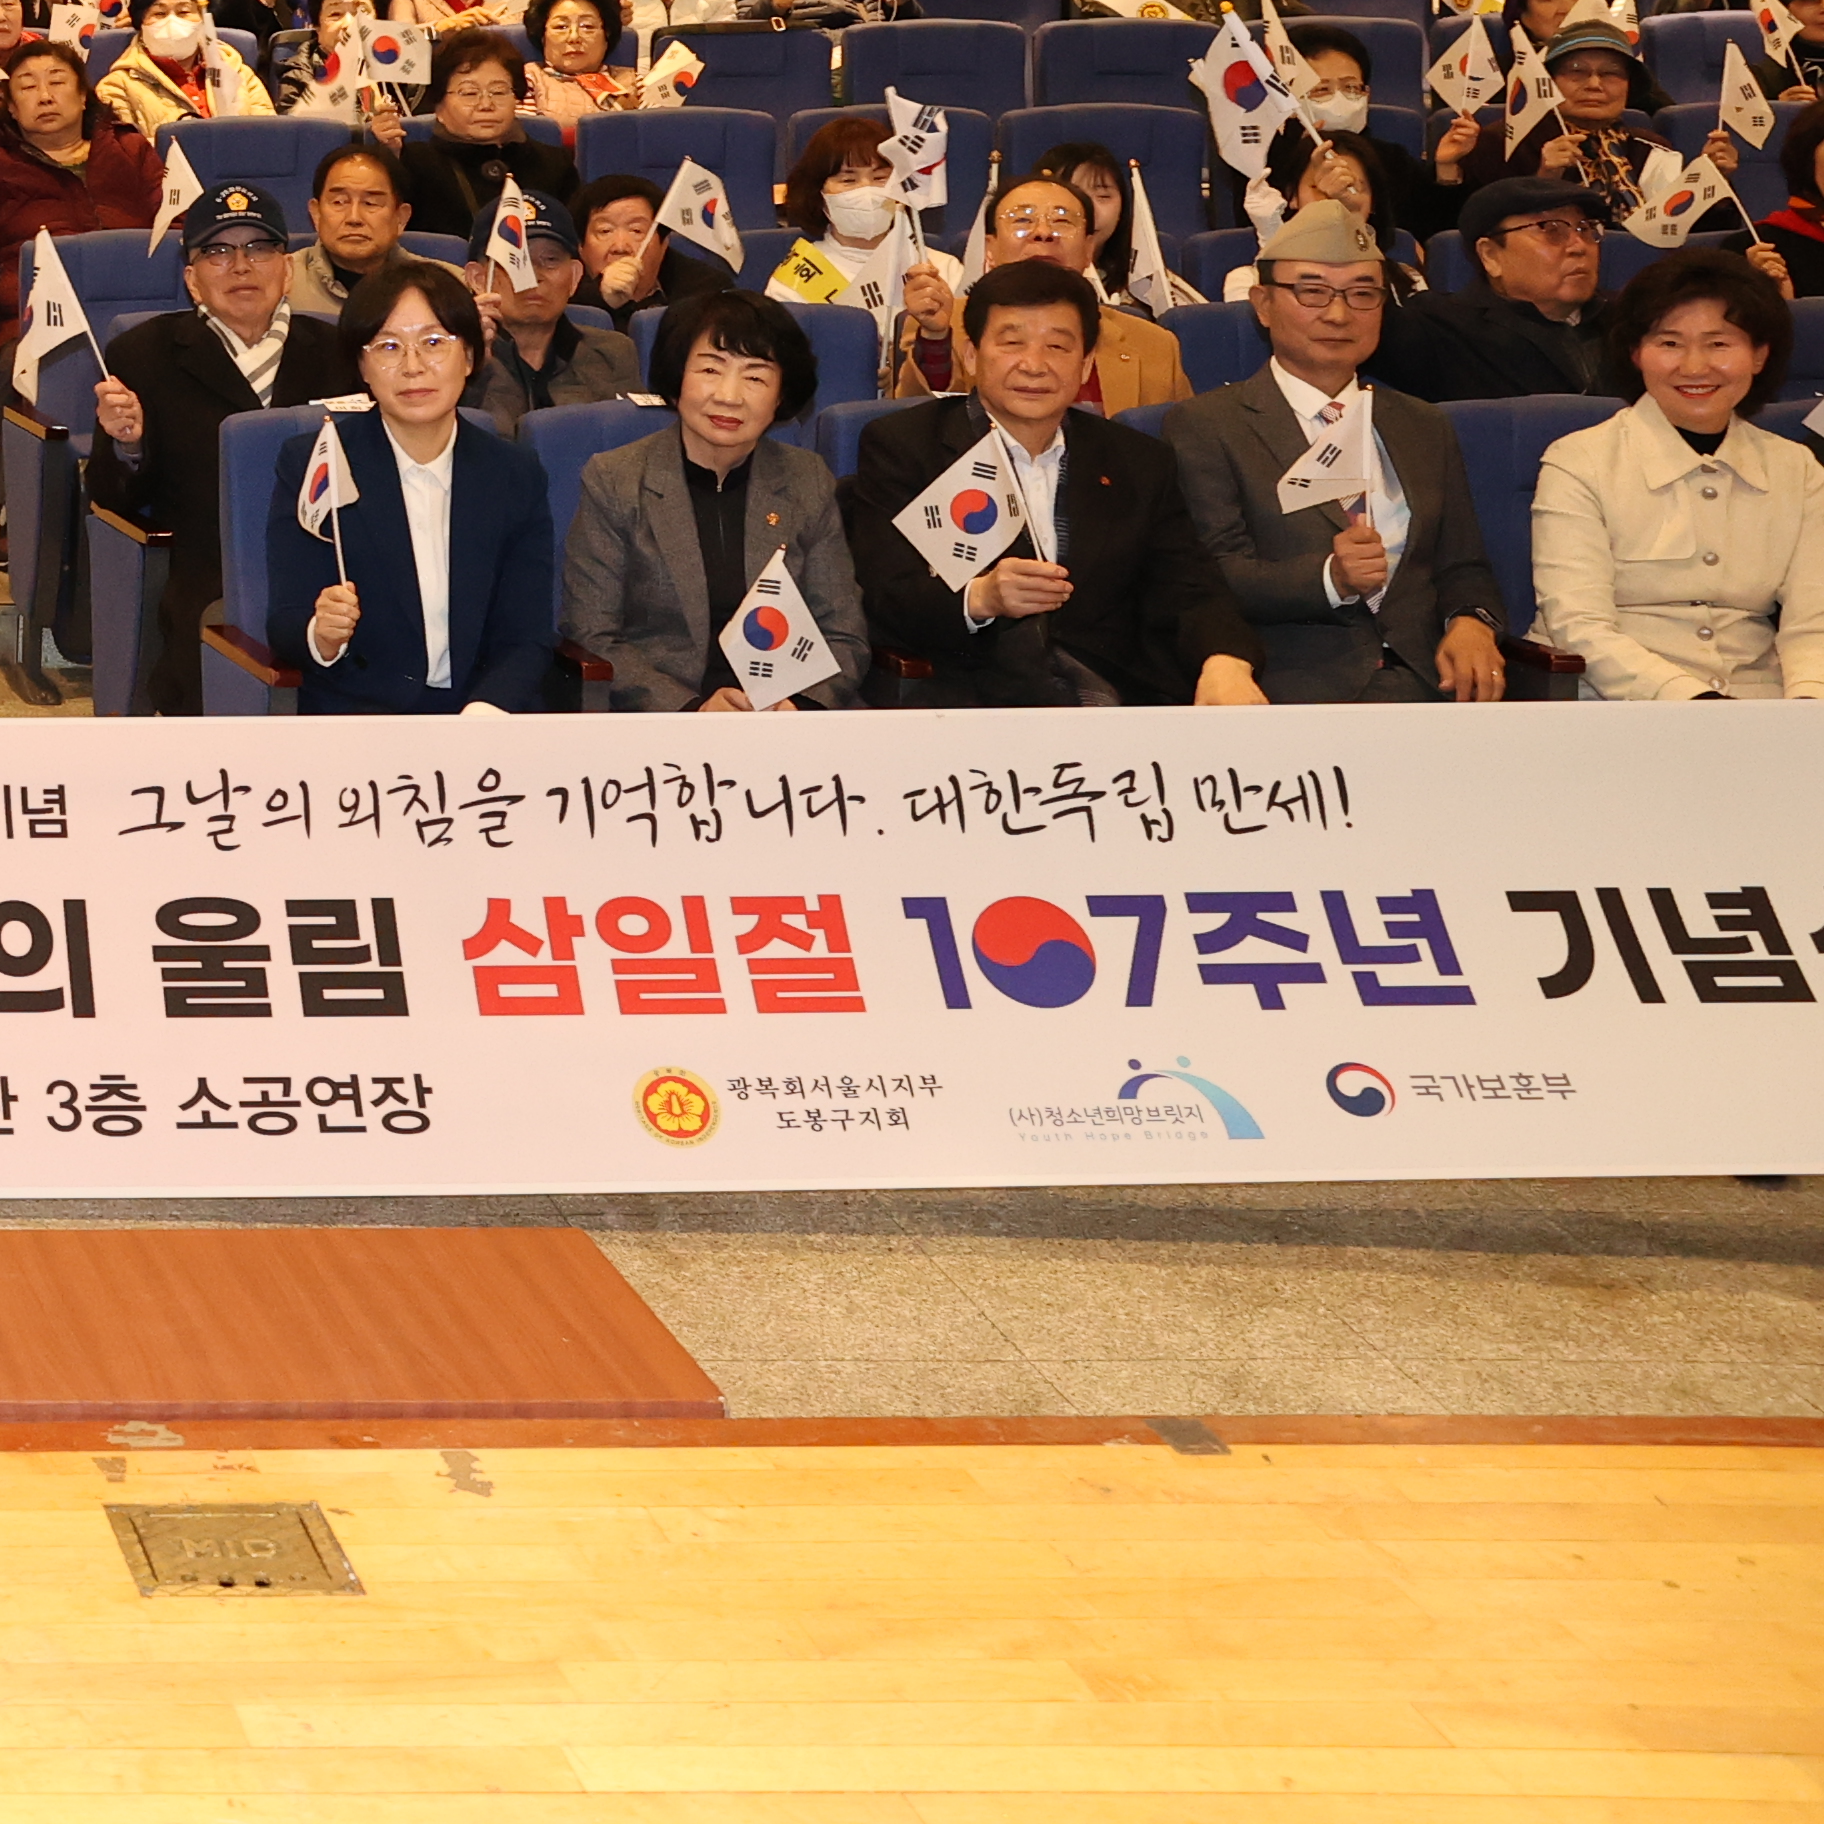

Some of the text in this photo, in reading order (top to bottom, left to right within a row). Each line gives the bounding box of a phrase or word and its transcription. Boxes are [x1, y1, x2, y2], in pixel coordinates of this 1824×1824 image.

[119, 761, 1352, 851] 그날의 외침을 기억합니다. 대한독립 만세!
[152, 897, 409, 1018] 울림
[462, 894, 866, 1016] 삼일절
[1505, 886, 1823, 1004] 기념
[726, 1075, 943, 1100] 광복회서울시지부
[1410, 1072, 1576, 1102] 국가보훈부
[46, 1075, 147, 1137] 3층
[176, 1073, 433, 1136] 소공연장
[1009, 1104, 1204, 1127] (사)청소년희망브릿지
[777, 1107, 909, 1132] 도봉구지회
[1085, 1131, 1132, 1141] Hope
